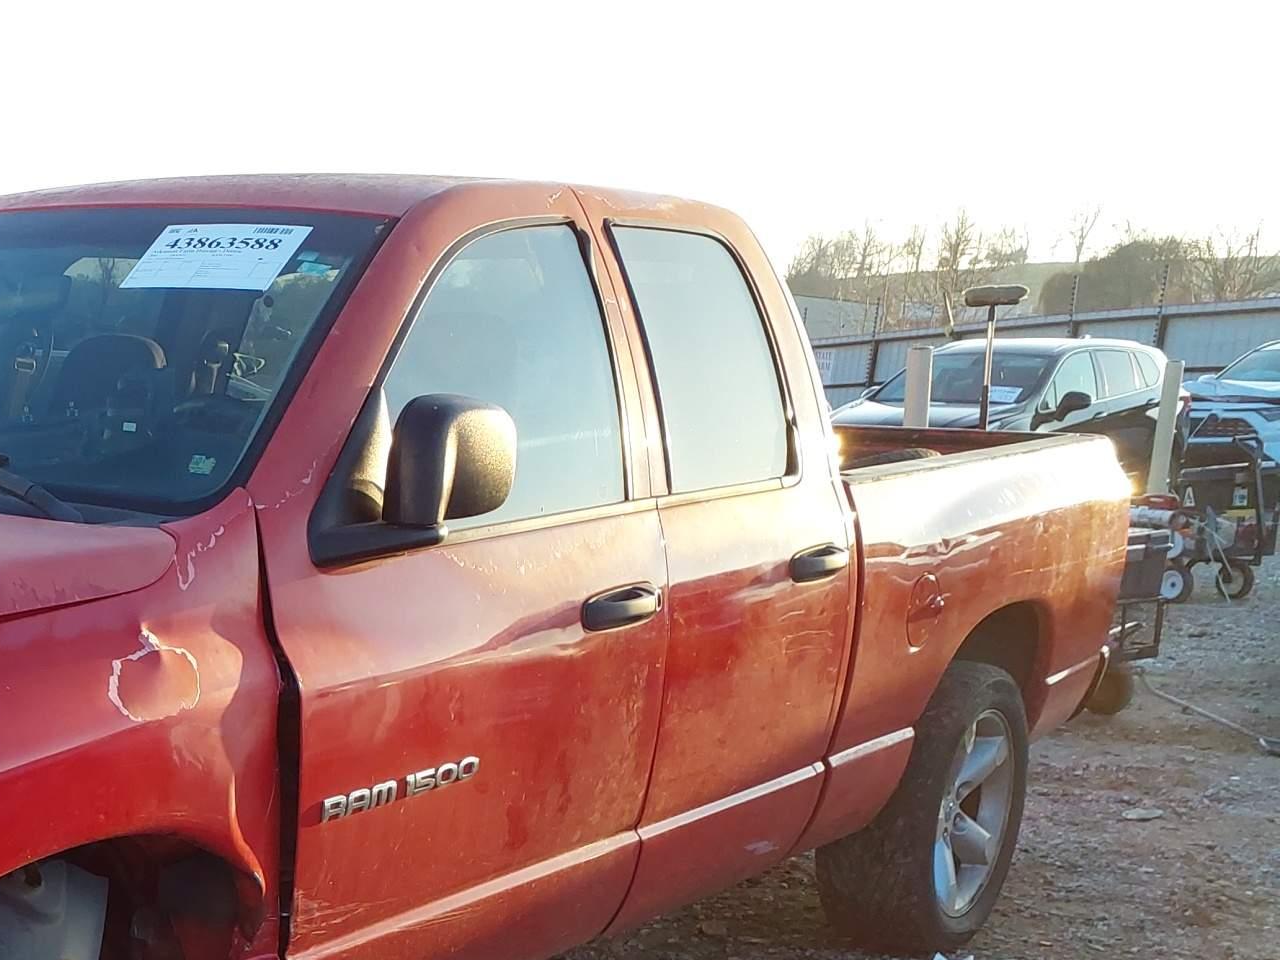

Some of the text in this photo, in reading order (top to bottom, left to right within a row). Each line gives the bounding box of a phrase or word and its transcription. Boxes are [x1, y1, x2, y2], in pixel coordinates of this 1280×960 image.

[165, 236, 283, 251] 43863588
[322, 755, 481, 824] RAM 1500
